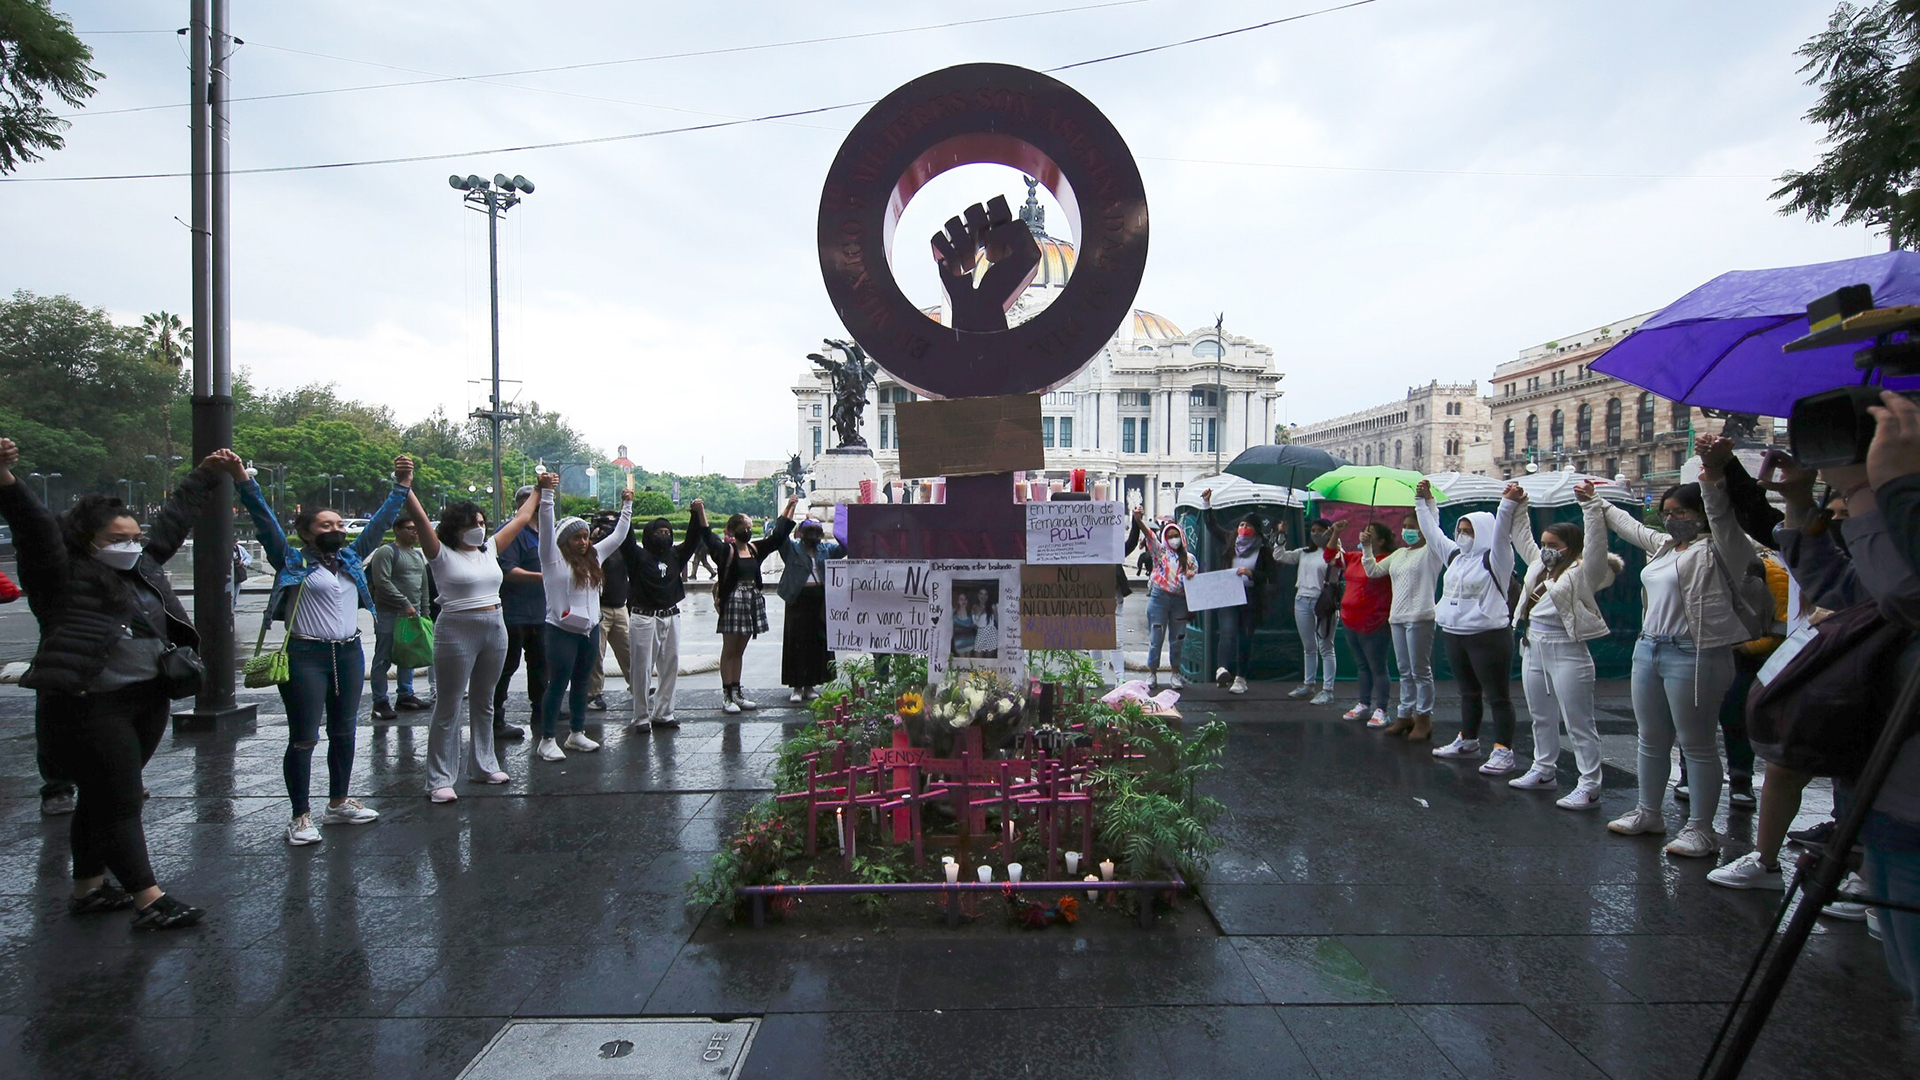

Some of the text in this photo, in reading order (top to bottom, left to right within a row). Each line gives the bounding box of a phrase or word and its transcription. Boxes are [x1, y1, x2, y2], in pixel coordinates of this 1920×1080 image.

[974, 86, 1036, 118] SON
[1030, 502, 1114, 516] En memoria de
[1029, 514, 1122, 530] Fernanda Olivares
[1050, 526, 1094, 543] POLLY
[1057, 566, 1081, 583] NO
[827, 566, 846, 588] Tu
[848, 570, 895, 603] partida
[1022, 582, 1103, 599] PERDONAMOS
[829, 606, 850, 622] será
[857, 611, 870, 625] en
[909, 606, 926, 626] tu
[1037, 599, 1106, 618] OLVIDAMOS
[836, 628, 864, 647] tribu
[869, 632, 891, 649] hará
[872, 750, 924, 764] WENDY
[702, 1031, 732, 1062] CFE
